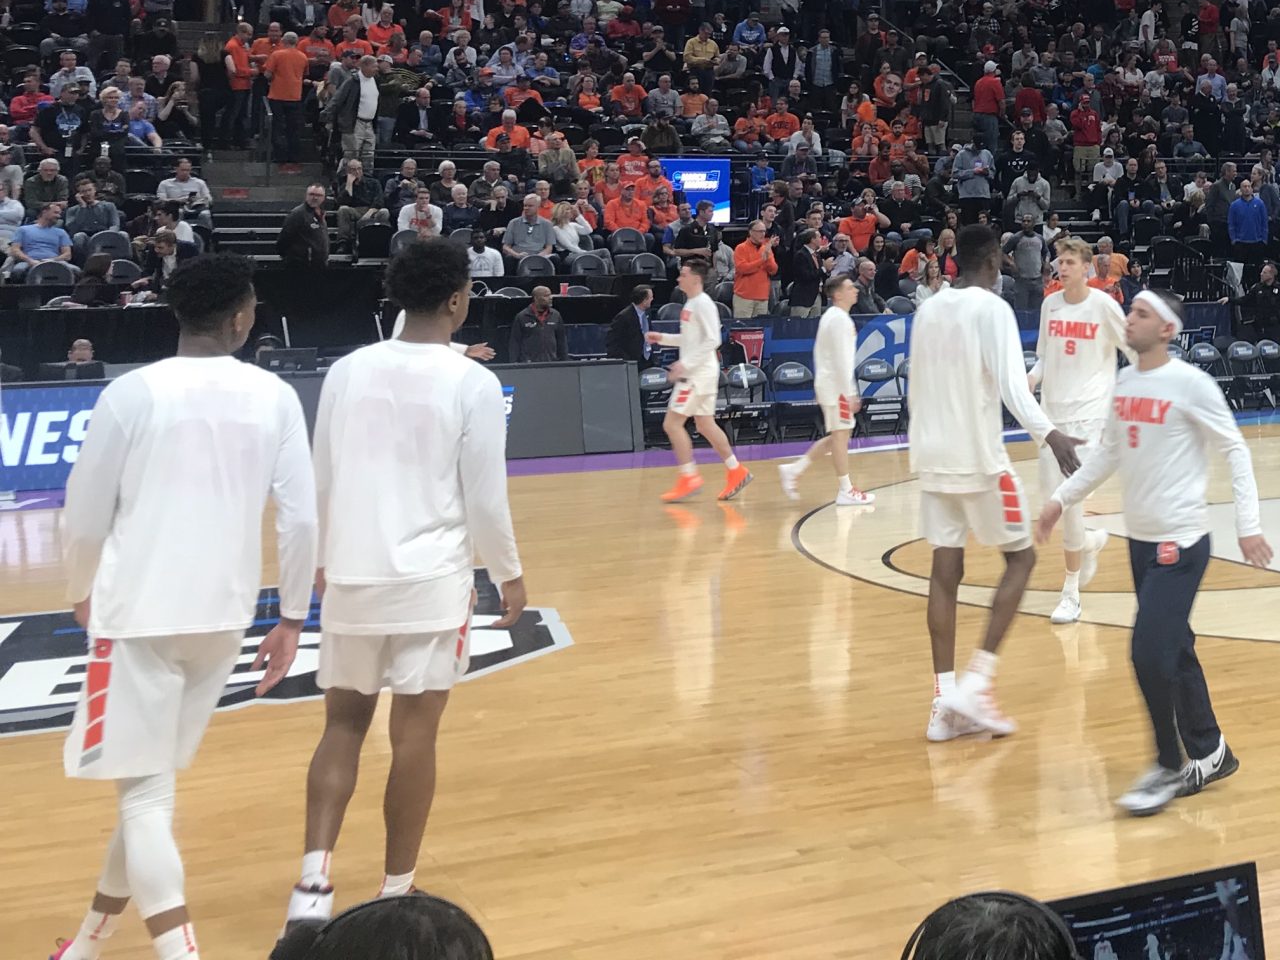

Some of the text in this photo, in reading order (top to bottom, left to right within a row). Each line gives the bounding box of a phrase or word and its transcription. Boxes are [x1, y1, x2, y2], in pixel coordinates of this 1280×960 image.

[1048, 320, 1100, 340] FAMILY
[1064, 340, 1076, 355] S
[1113, 396, 1173, 425] FAMILY
